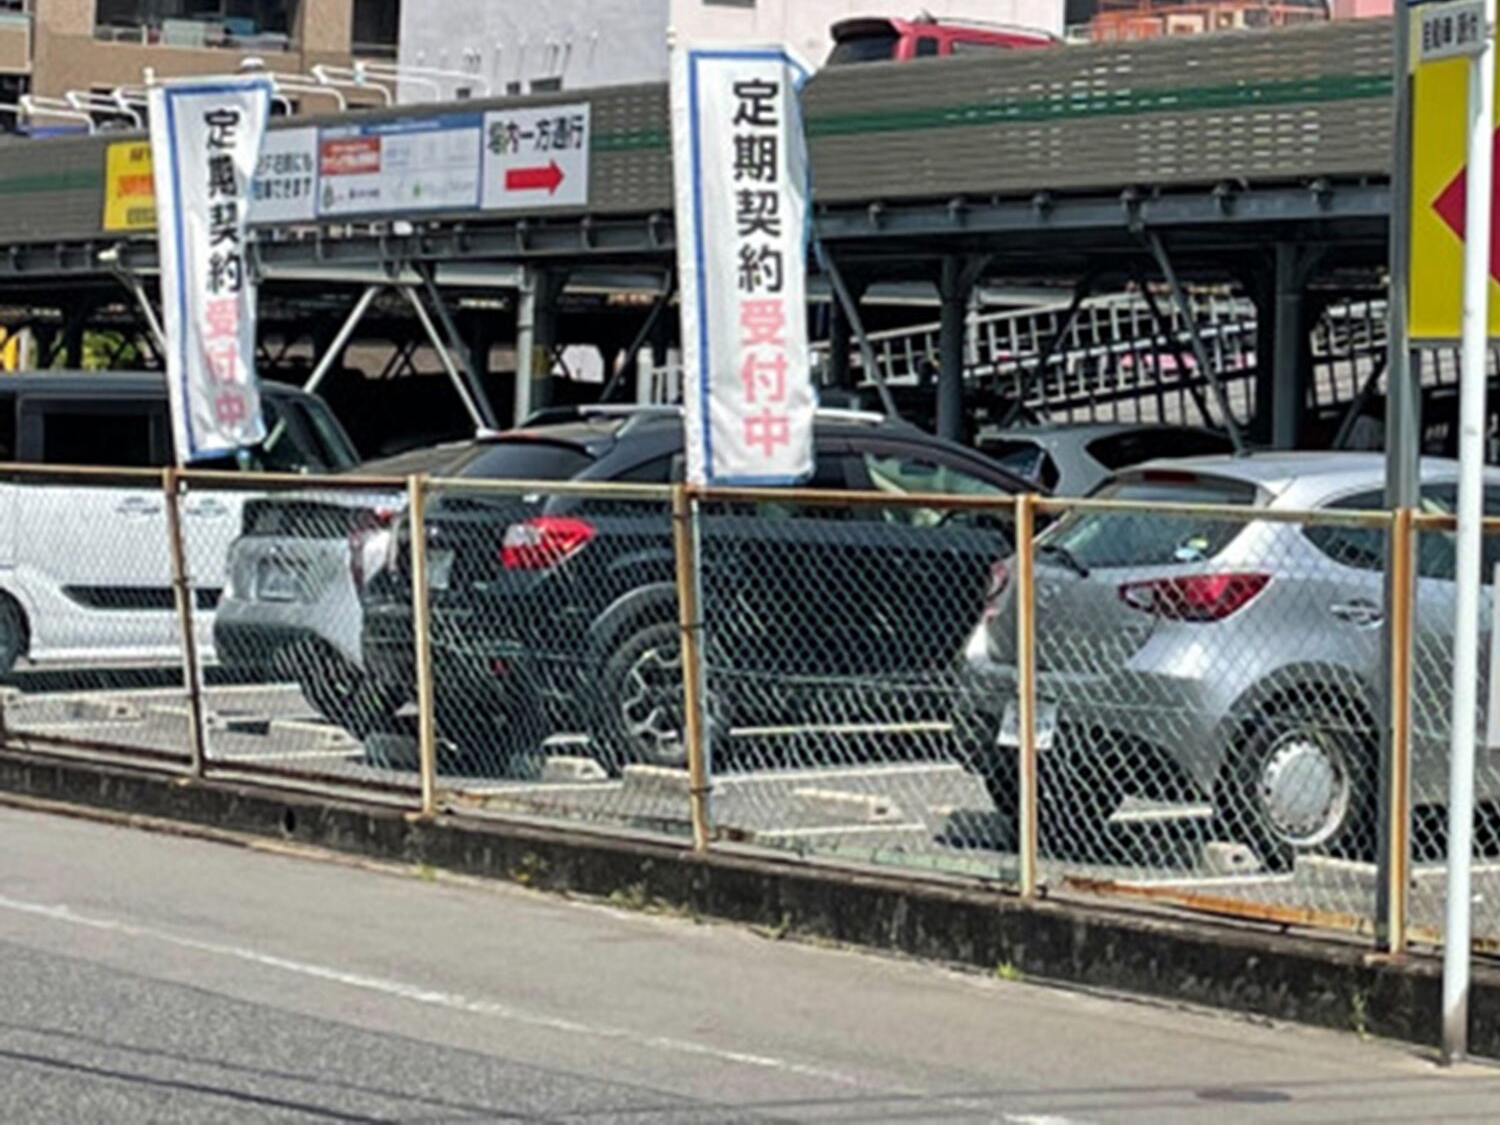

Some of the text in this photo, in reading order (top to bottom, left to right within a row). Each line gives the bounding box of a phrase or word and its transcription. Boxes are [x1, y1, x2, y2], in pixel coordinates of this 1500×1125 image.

[203, 108, 246, 427] 定期契約受付中
[732, 79, 790, 458] 定期契約受付中
